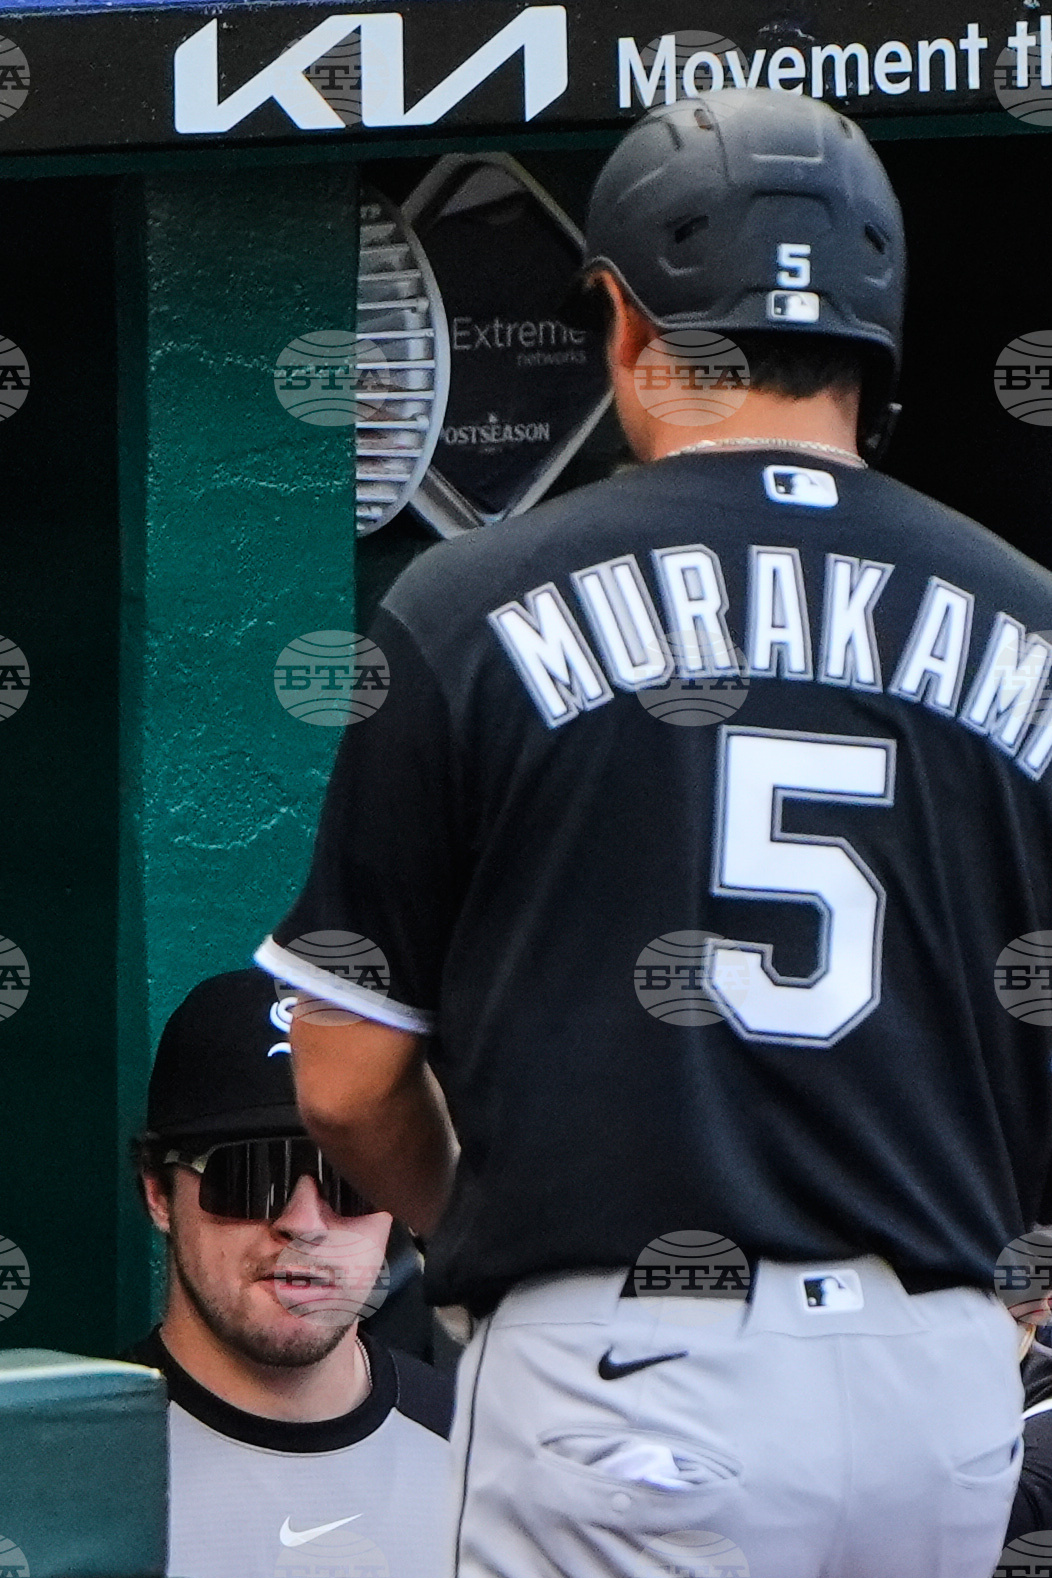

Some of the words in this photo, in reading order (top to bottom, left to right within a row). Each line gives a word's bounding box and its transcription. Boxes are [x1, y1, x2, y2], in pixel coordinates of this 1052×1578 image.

[174, 5, 567, 134] KIA
[618, 23, 988, 108] Movement
[776, 242, 811, 289] 5
[452, 316, 587, 351] Extreme
[443, 422, 551, 445] OSTSEASON
[704, 724, 897, 1048] 5
